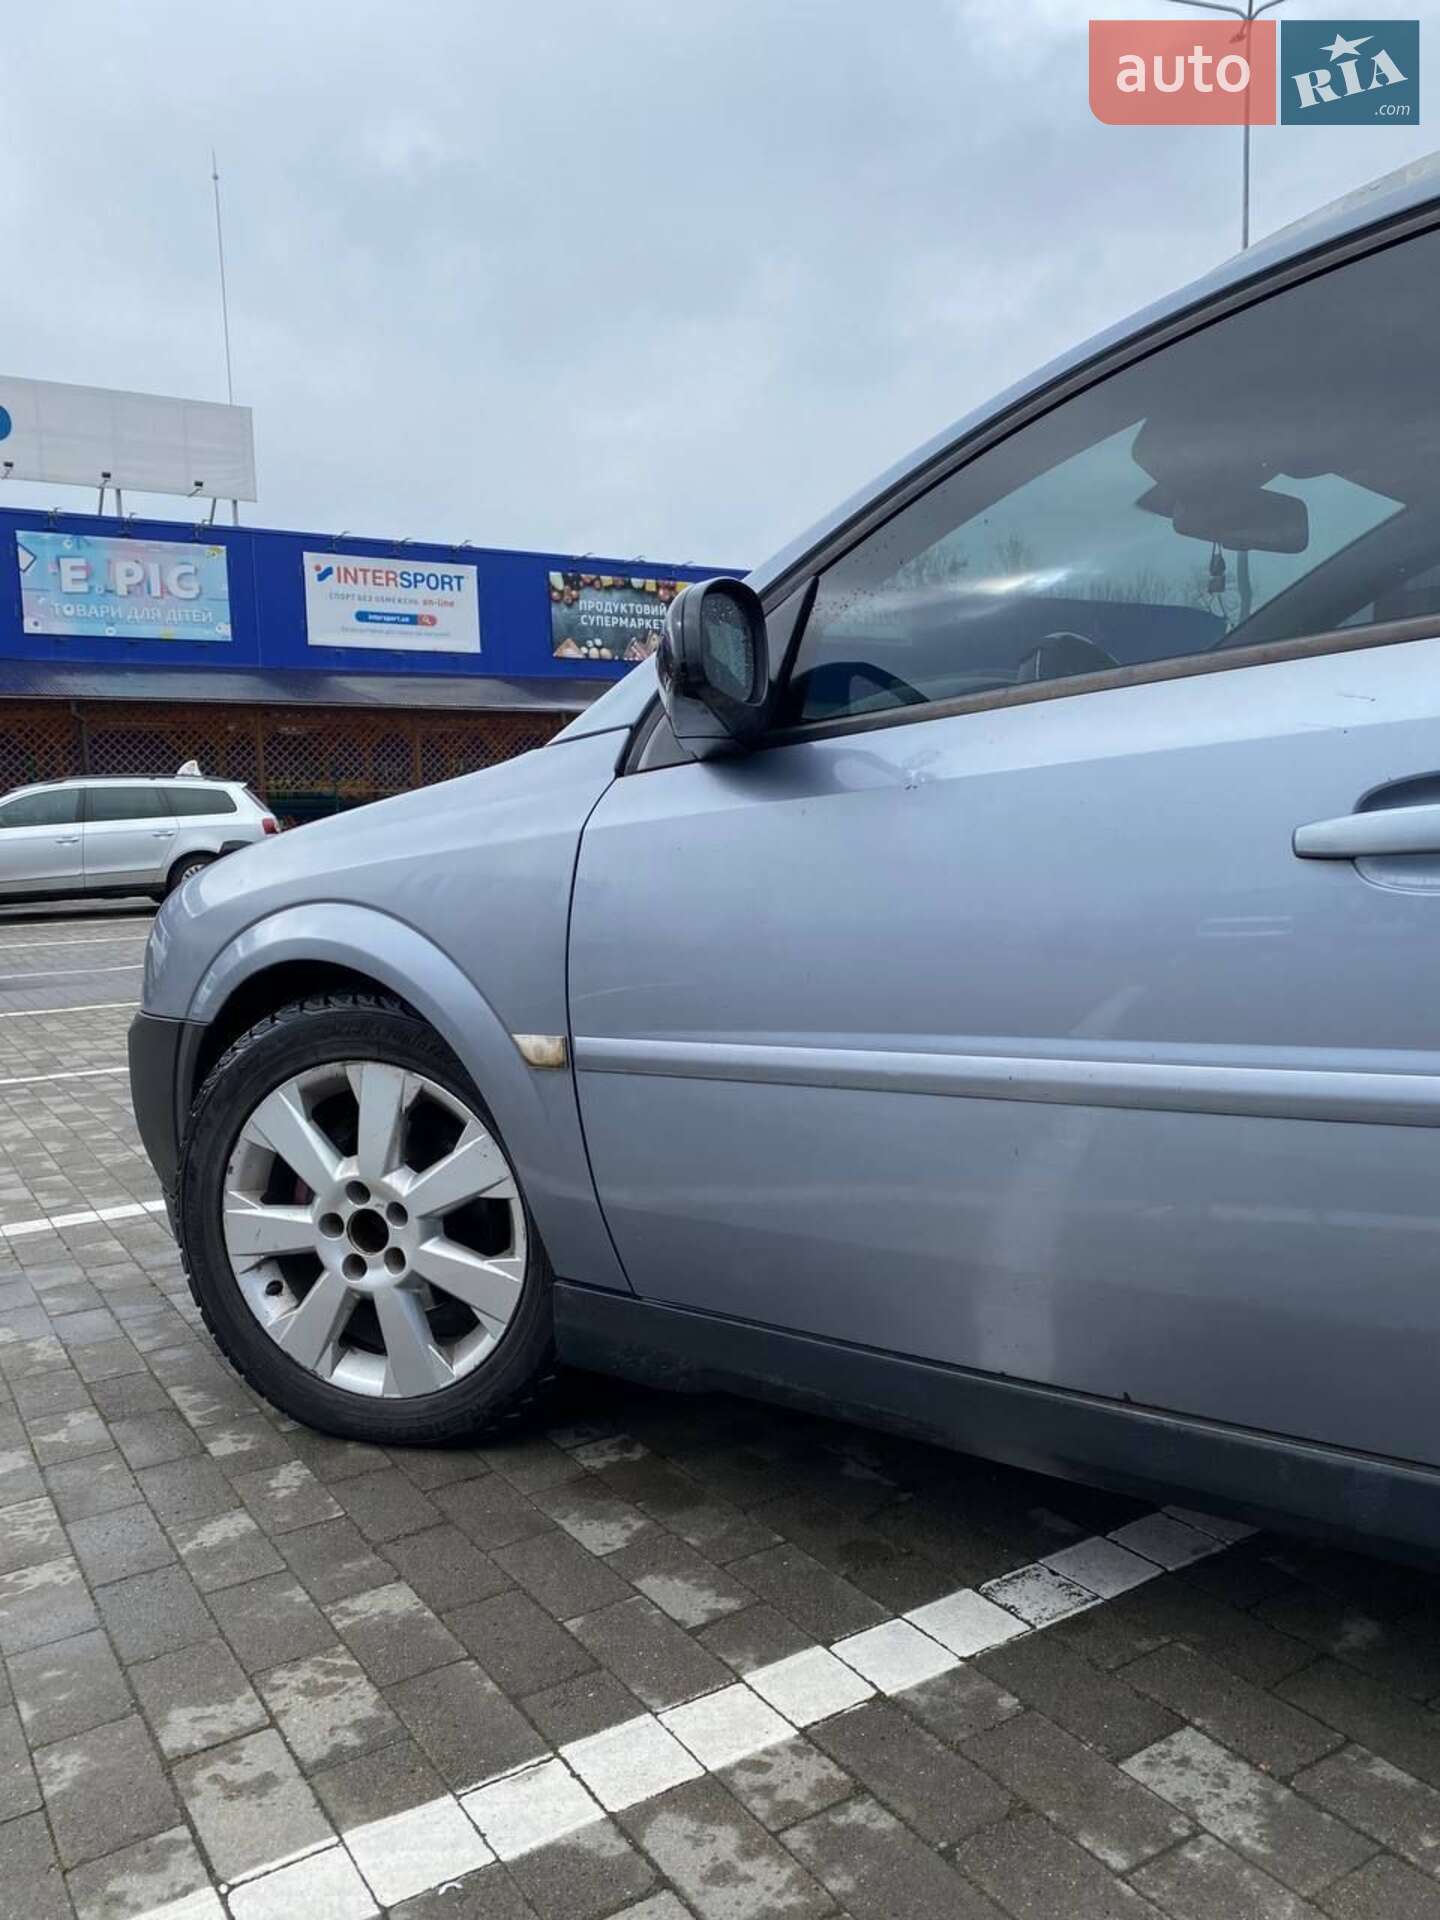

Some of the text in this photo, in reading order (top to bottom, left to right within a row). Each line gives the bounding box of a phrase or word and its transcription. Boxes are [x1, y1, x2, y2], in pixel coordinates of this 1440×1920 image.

[336, 566, 465, 592] INTERSPORT
[52, 602, 123, 619] ТОВАРИ
[126, 606, 162, 624] ДЛЯ
[578, 599, 667, 616] ПРОДУКТОВИЙ
